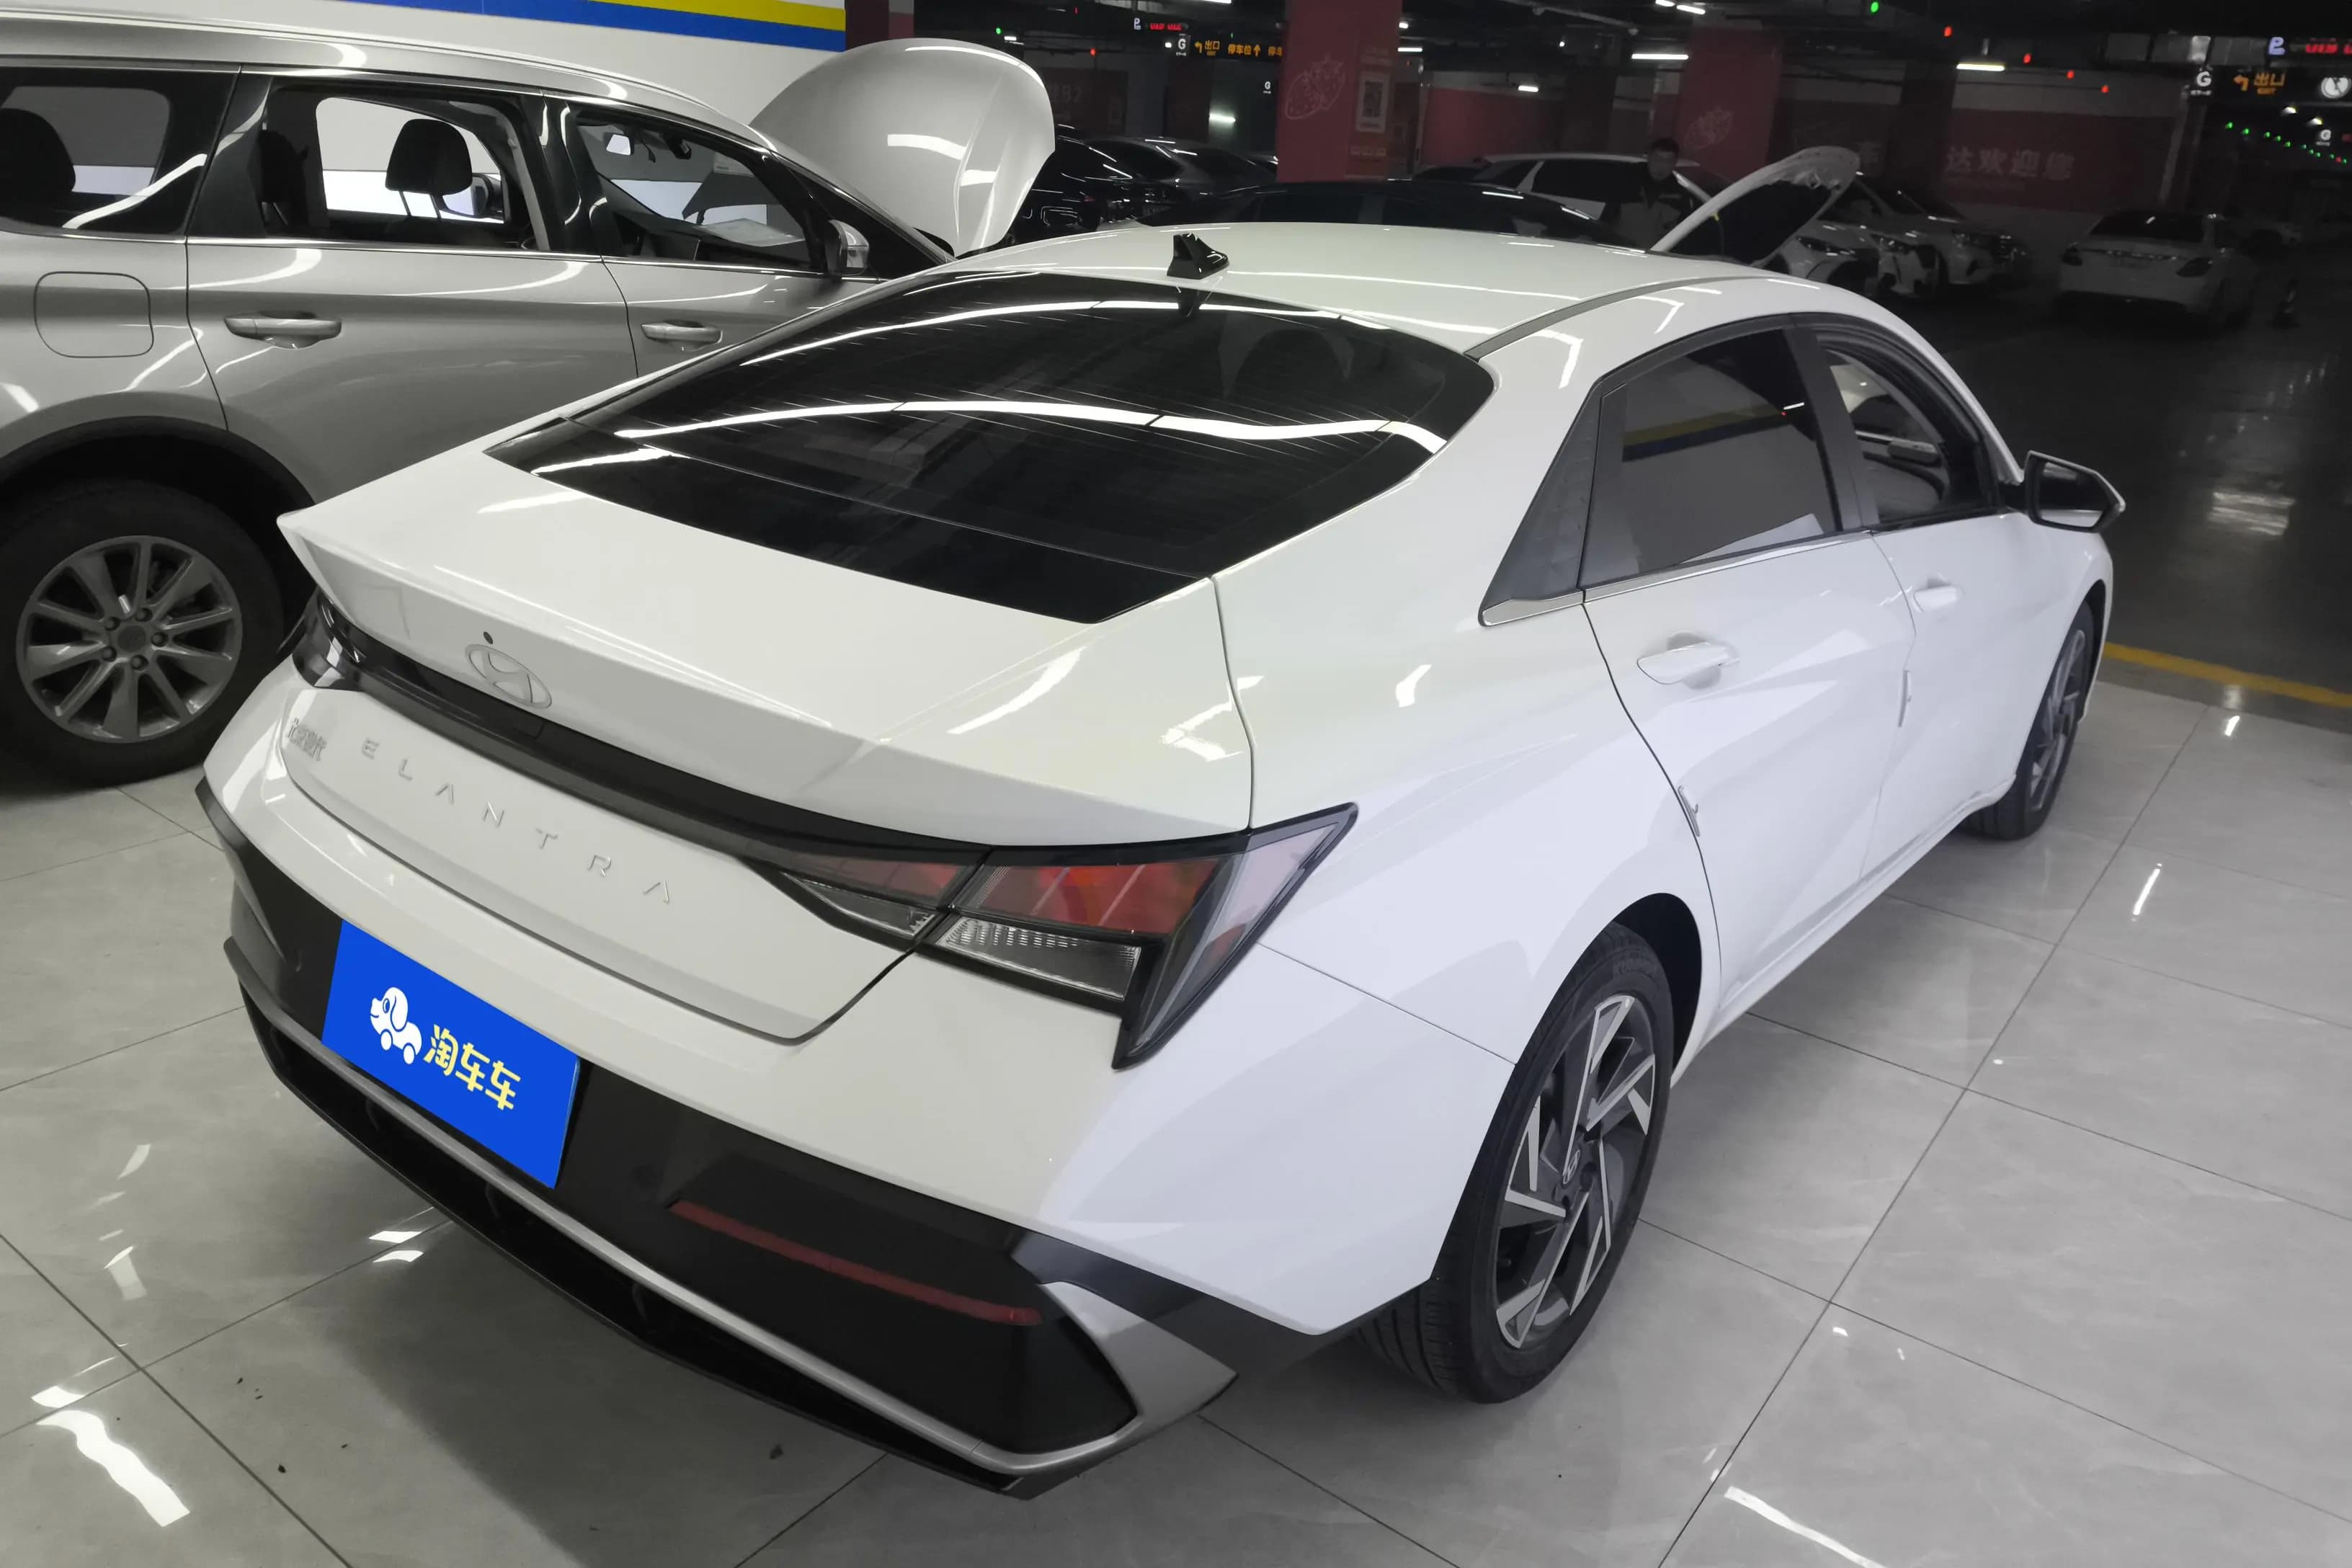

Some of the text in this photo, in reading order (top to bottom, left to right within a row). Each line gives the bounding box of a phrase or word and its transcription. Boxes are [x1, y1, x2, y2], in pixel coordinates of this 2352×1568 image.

[1177, 37, 1186, 50] G
[1204, 40, 1221, 50] 出口
[1227, 43, 1252, 55] 停车位
[2196, 71, 2212, 86] G
[1264, 81, 1271, 90] G
[361, 737, 670, 905] ELANTRA
